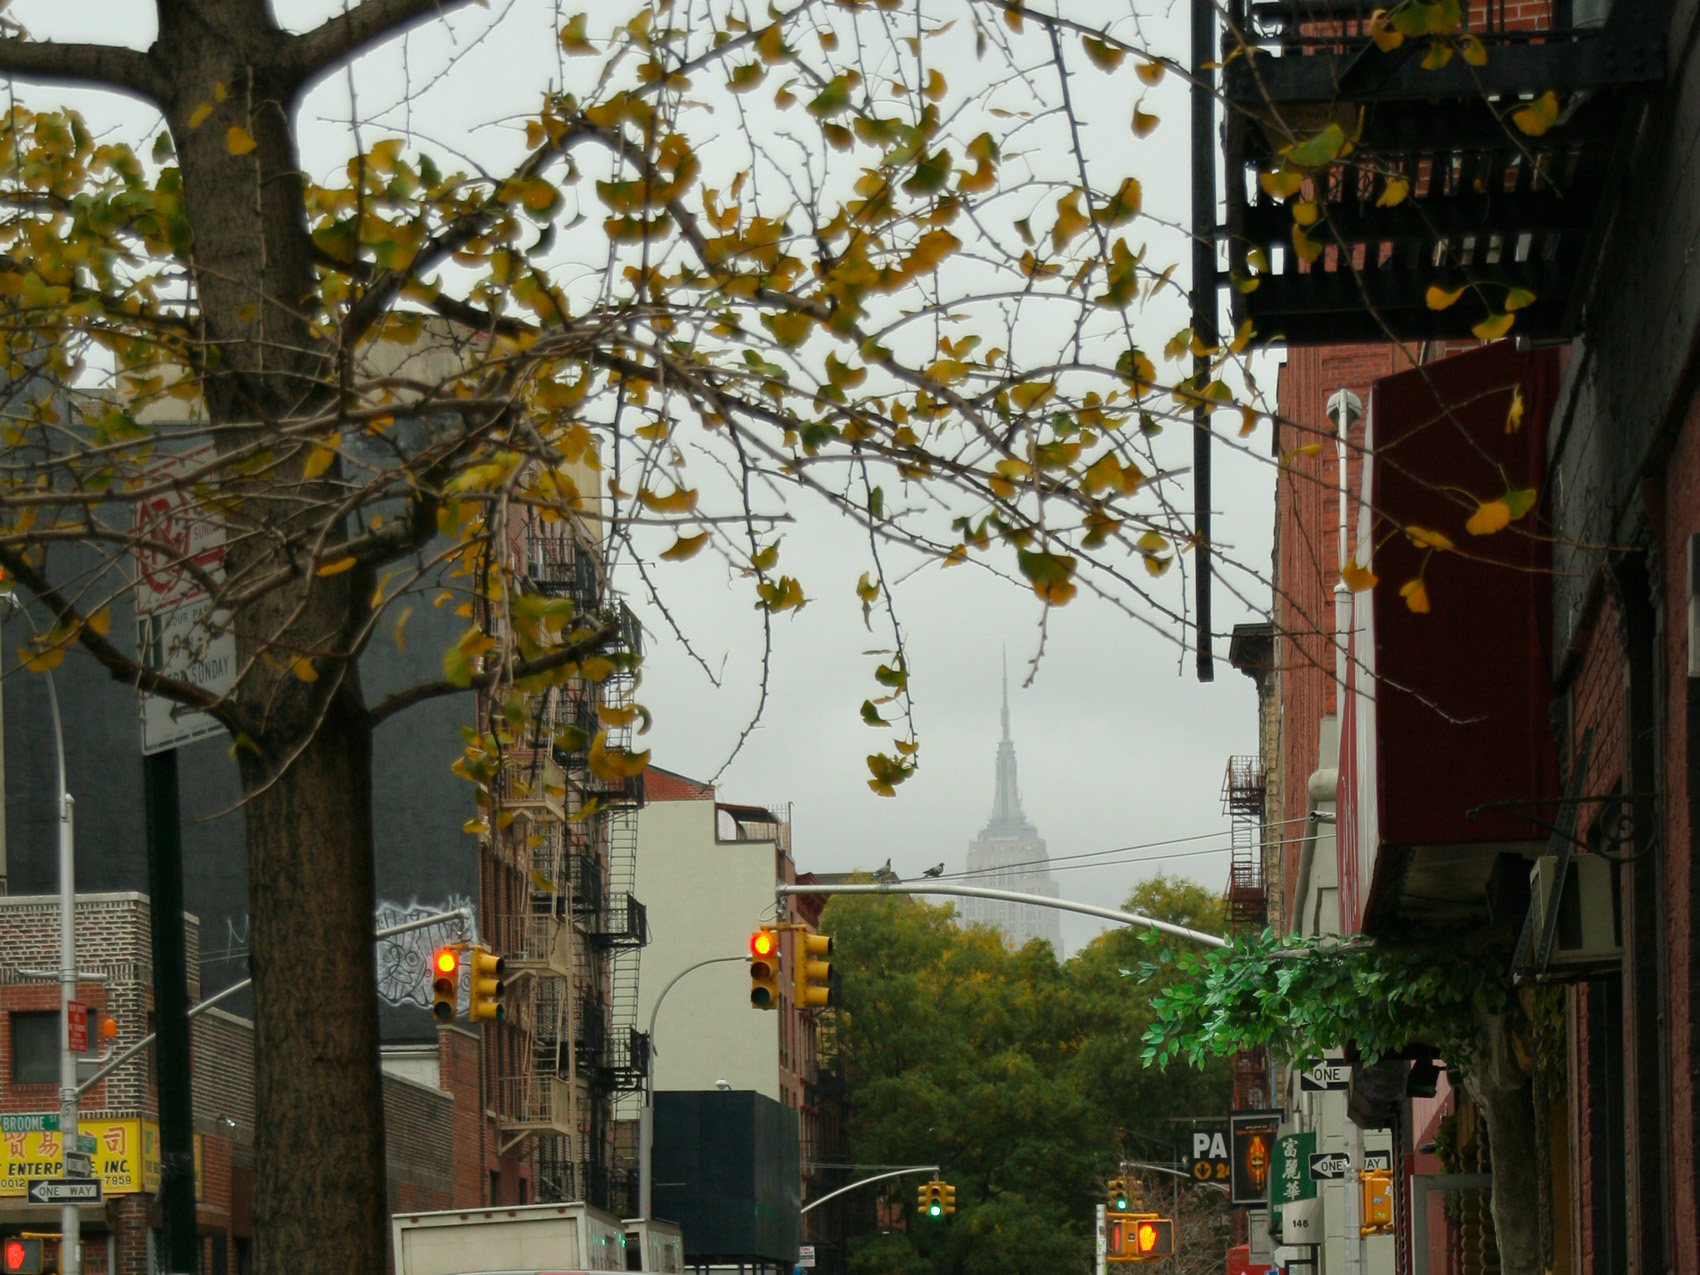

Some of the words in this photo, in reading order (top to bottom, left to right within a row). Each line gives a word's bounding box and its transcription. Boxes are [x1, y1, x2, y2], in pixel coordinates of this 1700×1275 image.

[191, 656, 230, 684] SUNDAY
[1314, 1068, 1341, 1081] ONE
[2, 1116, 46, 1131] BROOME
[104, 1159, 130, 1173] INC.
[1320, 1161, 1343, 1172] ONE
[1364, 1158, 1381, 1169] AY
[38, 1186, 60, 1197] ONE
[70, 1186, 92, 1196] WAY
[1292, 1219, 1309, 1229] 146
